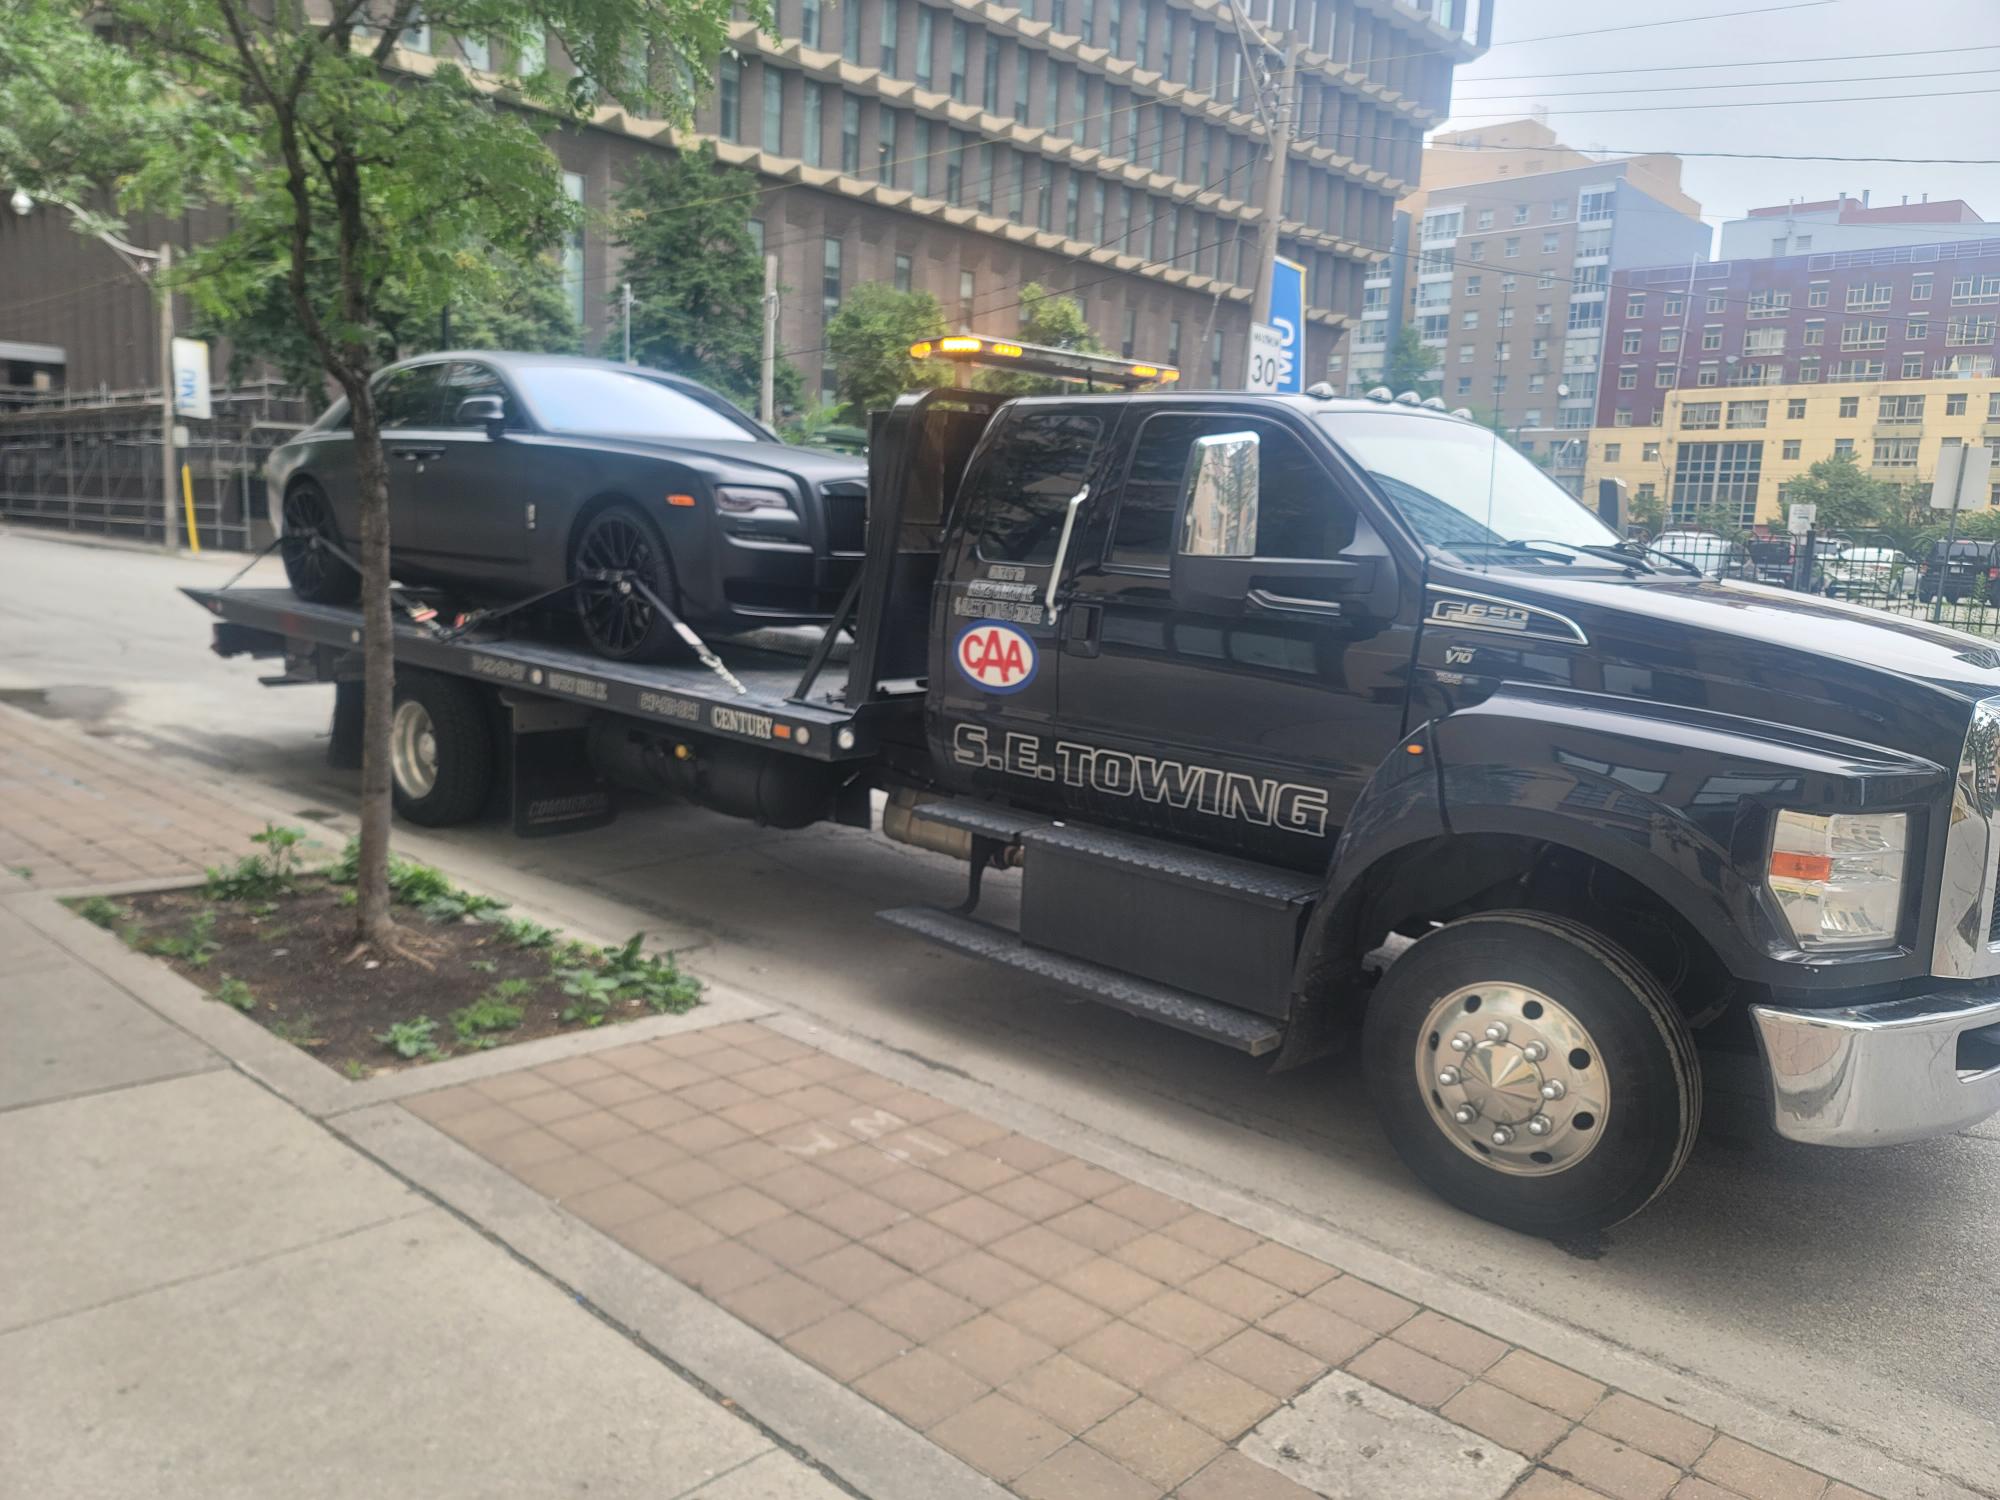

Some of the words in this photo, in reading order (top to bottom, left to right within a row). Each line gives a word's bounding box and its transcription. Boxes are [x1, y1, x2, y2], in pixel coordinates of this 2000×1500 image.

[1251, 354, 1276, 387] 30
[963, 630, 1026, 683] CAA
[1446, 649, 1473, 664] V10
[713, 705, 774, 739] CENTURY
